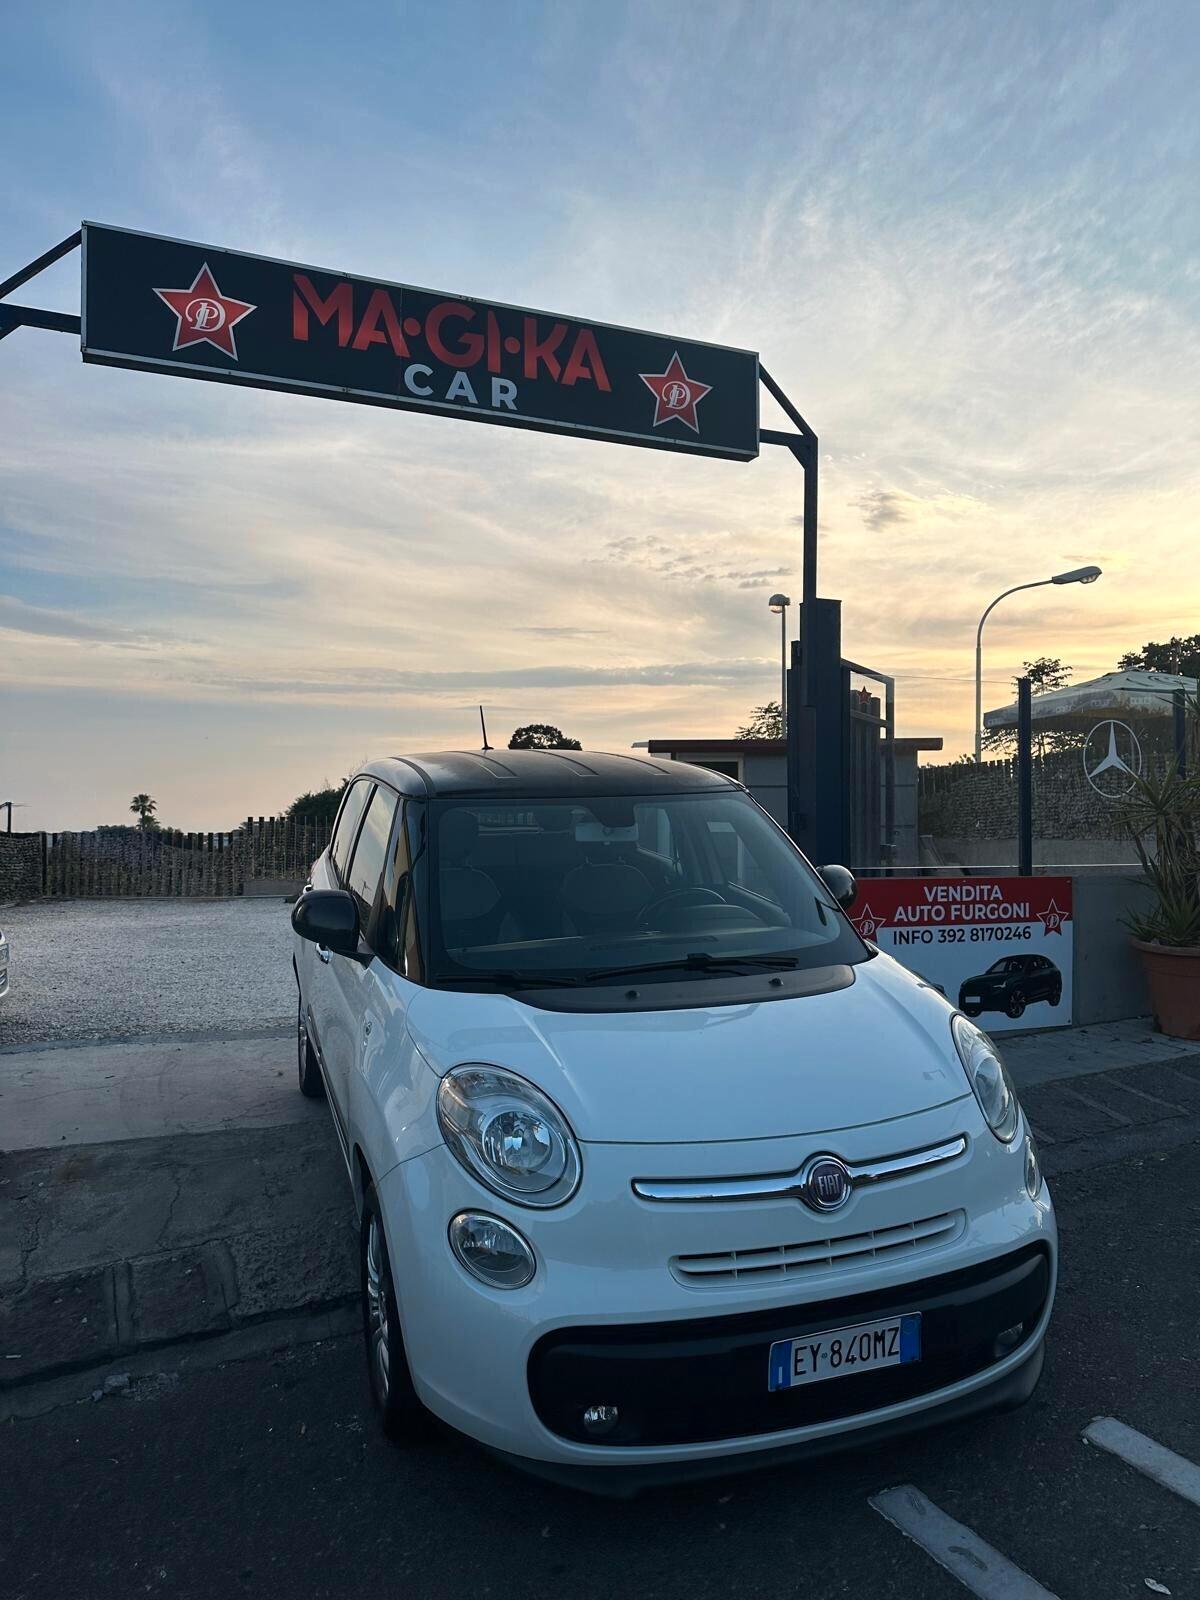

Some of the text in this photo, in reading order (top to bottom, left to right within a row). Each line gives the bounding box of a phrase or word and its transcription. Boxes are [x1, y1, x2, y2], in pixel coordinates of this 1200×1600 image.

[404, 363, 518, 411] CAR
[923, 885, 1003, 902] VENDITA
[894, 902, 1030, 922] AUTO FURGONI
[893, 926, 1031, 945] INFO 392 8170246
[817, 1173, 839, 1197] FIAT
